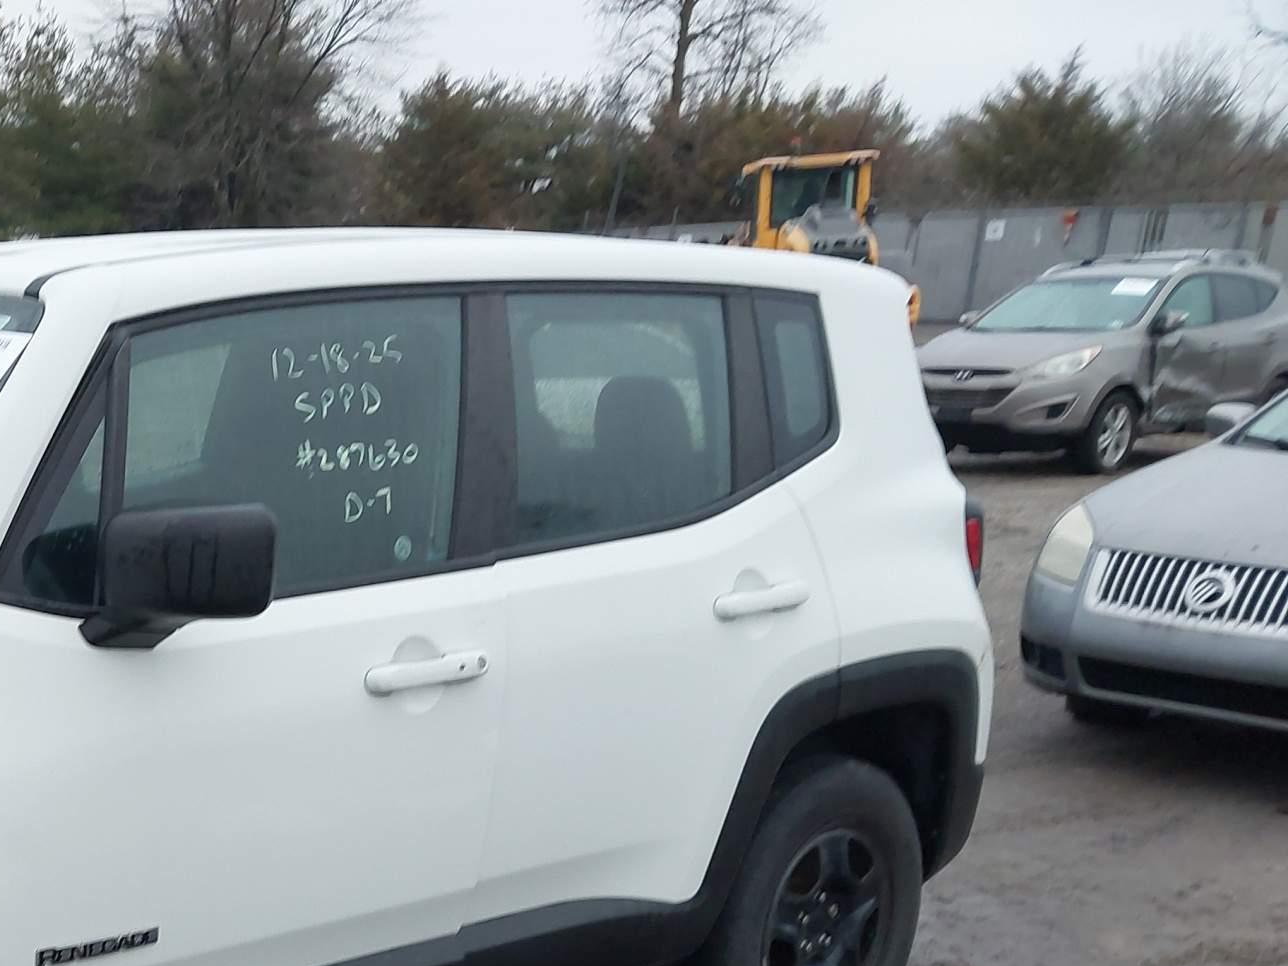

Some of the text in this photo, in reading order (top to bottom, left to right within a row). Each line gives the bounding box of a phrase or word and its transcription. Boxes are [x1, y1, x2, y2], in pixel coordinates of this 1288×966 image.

[272, 334, 403, 382] 12-18-25
[293, 382, 382, 424] SPPD
[295, 438, 419, 471] #287630
[343, 486, 392, 524] D-7
